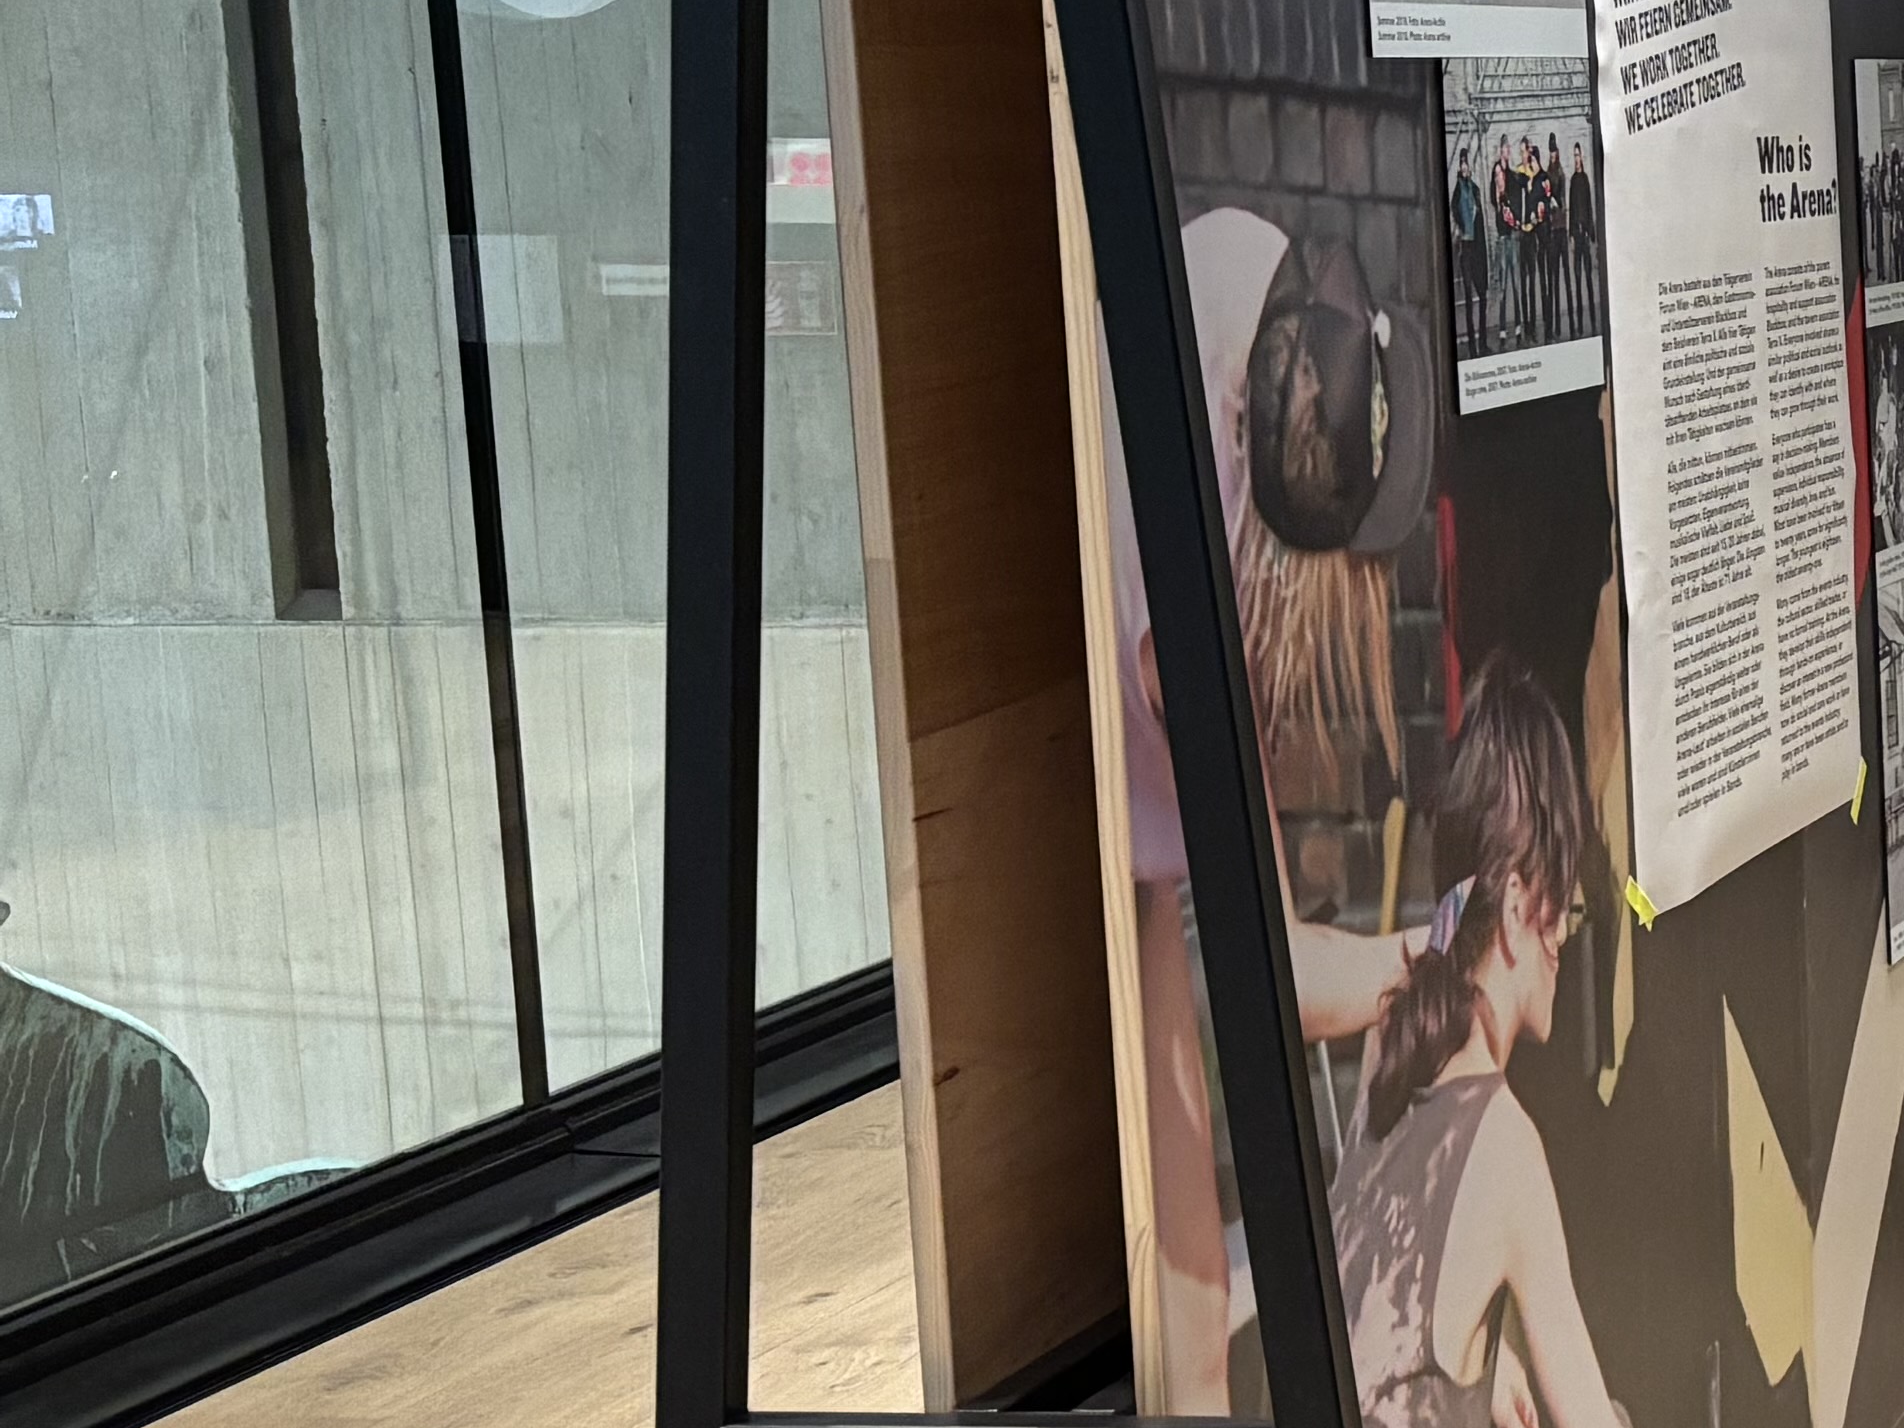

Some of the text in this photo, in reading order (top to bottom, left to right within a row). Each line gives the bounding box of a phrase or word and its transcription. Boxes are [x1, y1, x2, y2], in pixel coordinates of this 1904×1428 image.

[1615, 15, 1638, 49] WIR
[1638, 1, 1672, 42] FEIERN
[1620, 33, 1720, 95] WE WORK TOGETHER.
[1624, 62, 1746, 135] WE CELEBRATE TOGETHER.
[1756, 135, 1812, 174] Who is
[1760, 178, 1837, 222] the Arena?
